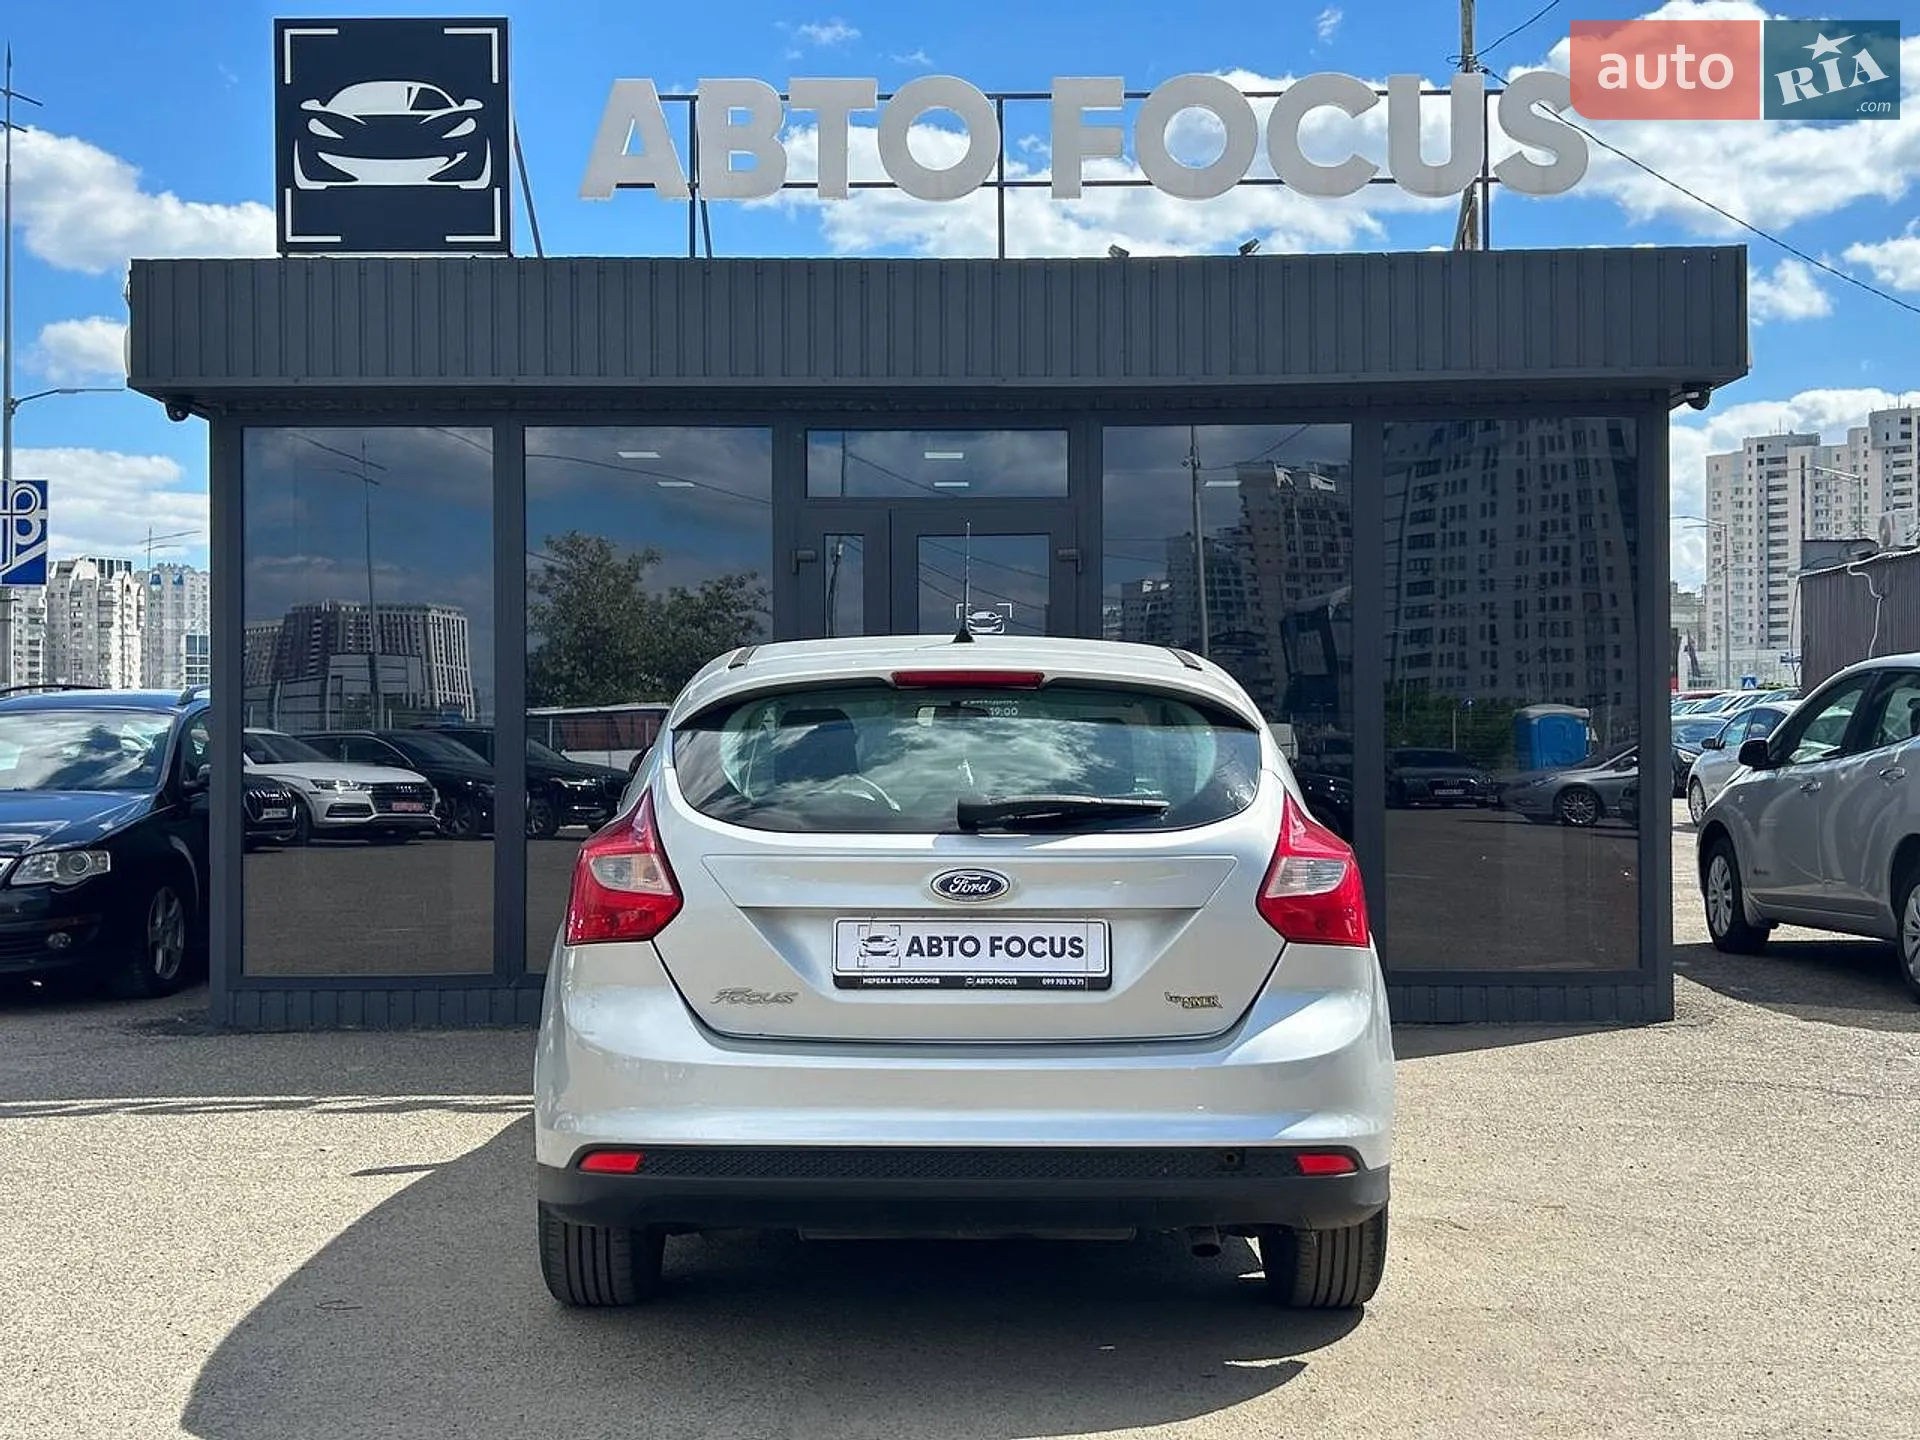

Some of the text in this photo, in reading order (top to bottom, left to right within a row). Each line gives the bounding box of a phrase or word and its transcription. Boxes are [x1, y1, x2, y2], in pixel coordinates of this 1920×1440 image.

[578, 72, 1590, 201] АВТО FOCUS
[949, 874, 992, 894] Ford
[905, 935, 1085, 958] АВТО FOCUS
[995, 977, 1018, 985] FOCUS
